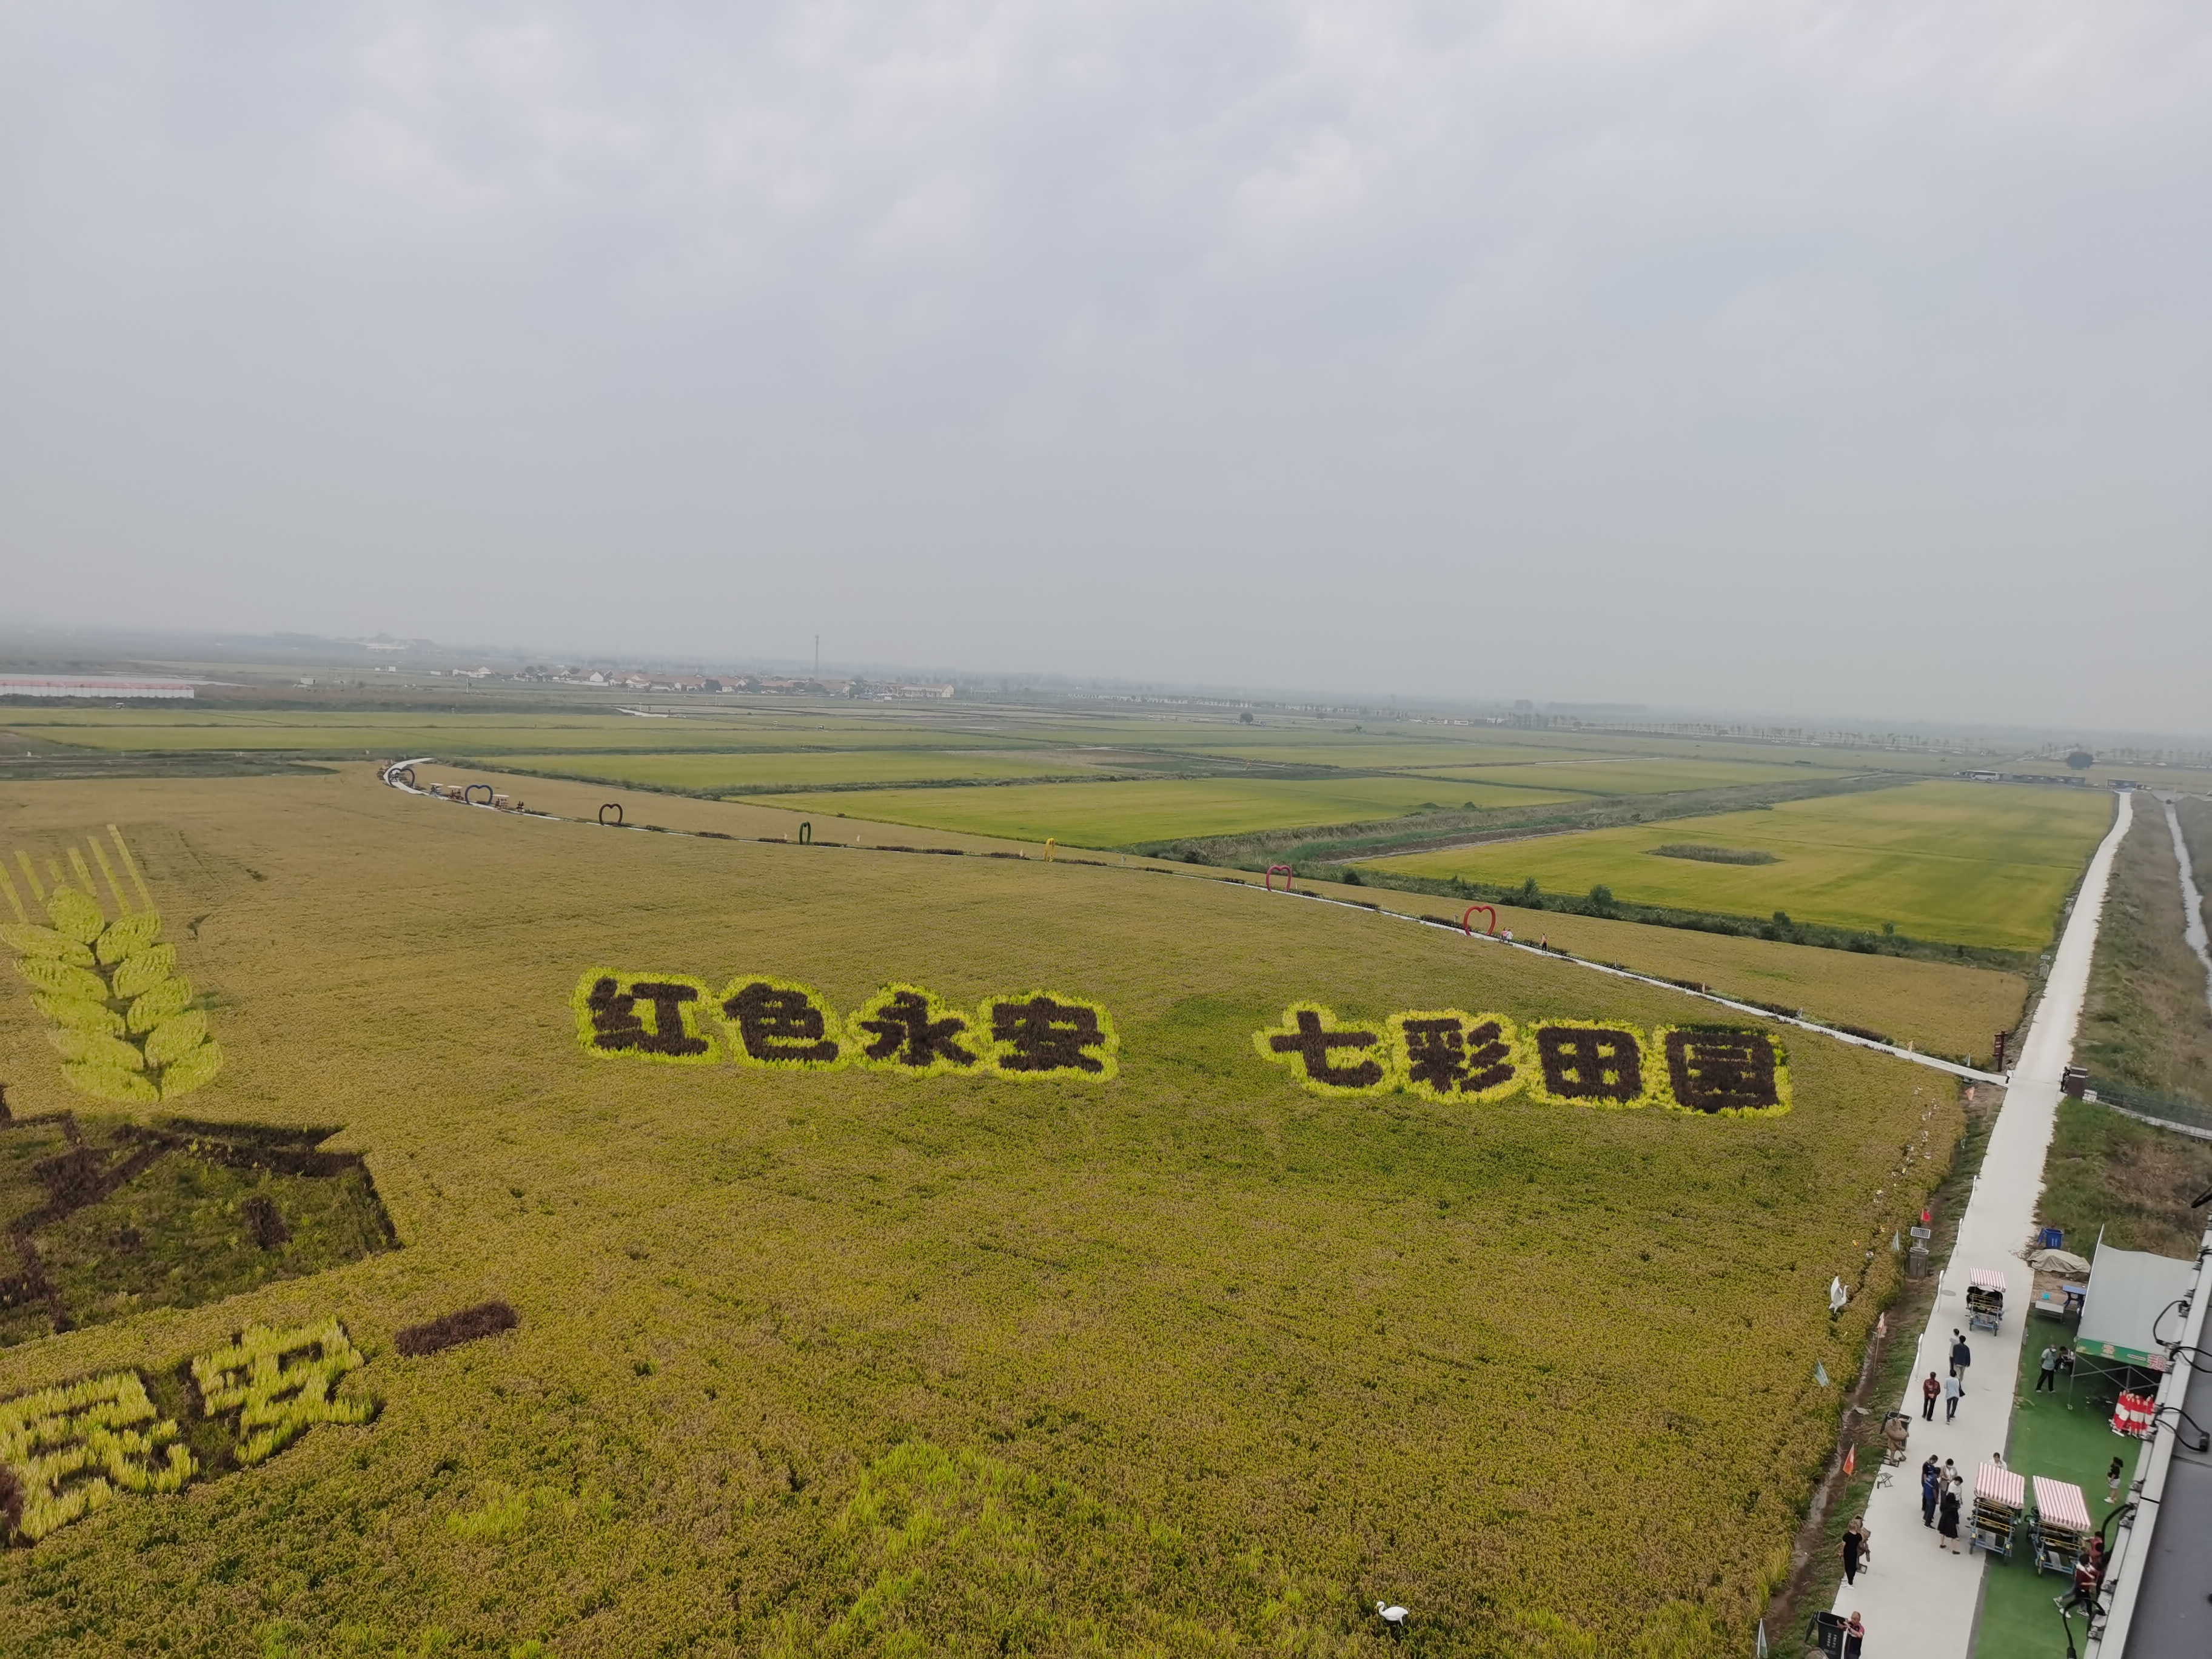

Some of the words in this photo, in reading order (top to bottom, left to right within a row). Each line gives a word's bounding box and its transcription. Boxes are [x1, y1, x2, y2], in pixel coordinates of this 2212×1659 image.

[588, 976, 1106, 1075] 红色永安
[1269, 1010, 1780, 1114] 七彩田园
